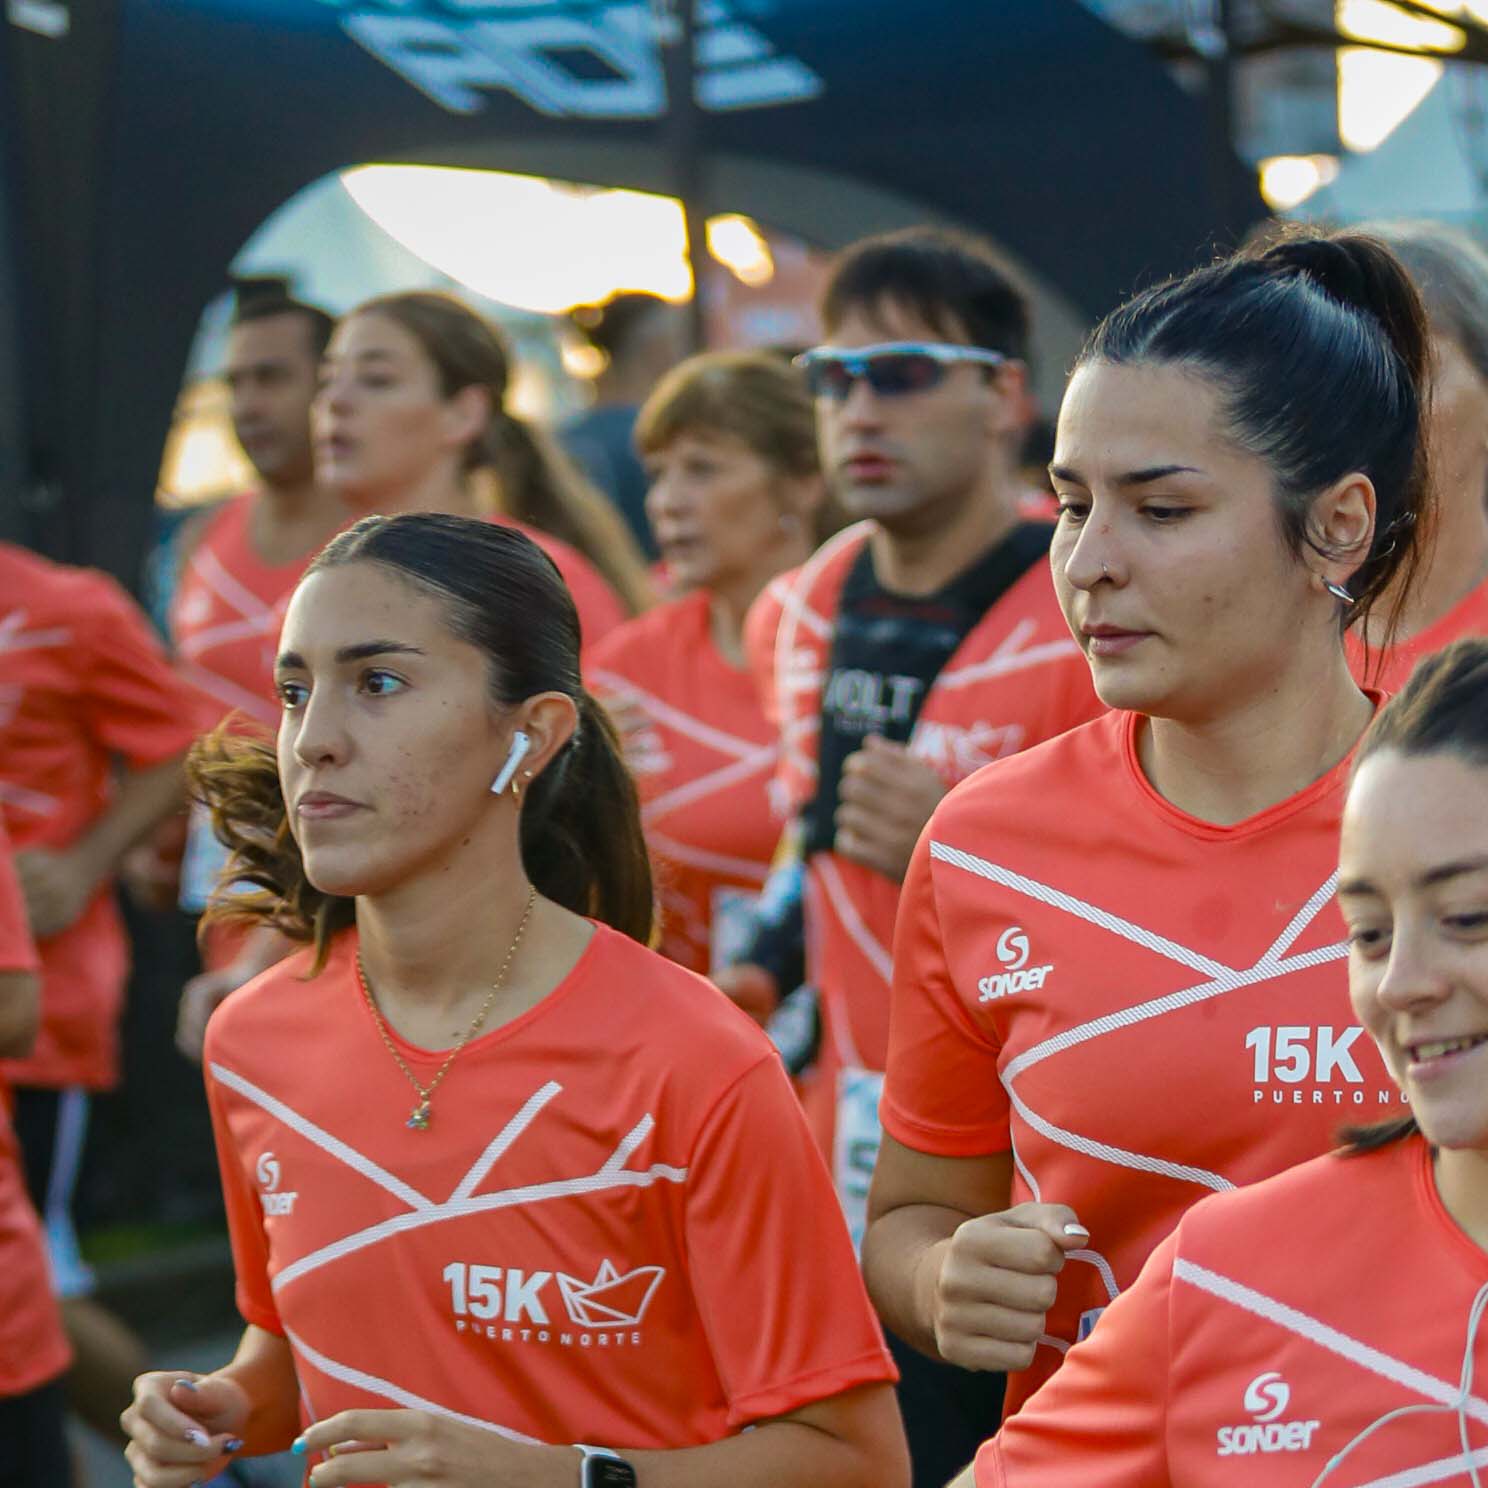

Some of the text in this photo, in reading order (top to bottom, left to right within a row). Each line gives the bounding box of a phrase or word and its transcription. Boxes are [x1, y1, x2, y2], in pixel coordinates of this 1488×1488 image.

[1245, 1026, 1365, 1083] 15K
[1254, 1090, 1364, 1105] PUERTO
[443, 1262, 553, 1325] 15K
[560, 1331, 642, 1346] NORTE
